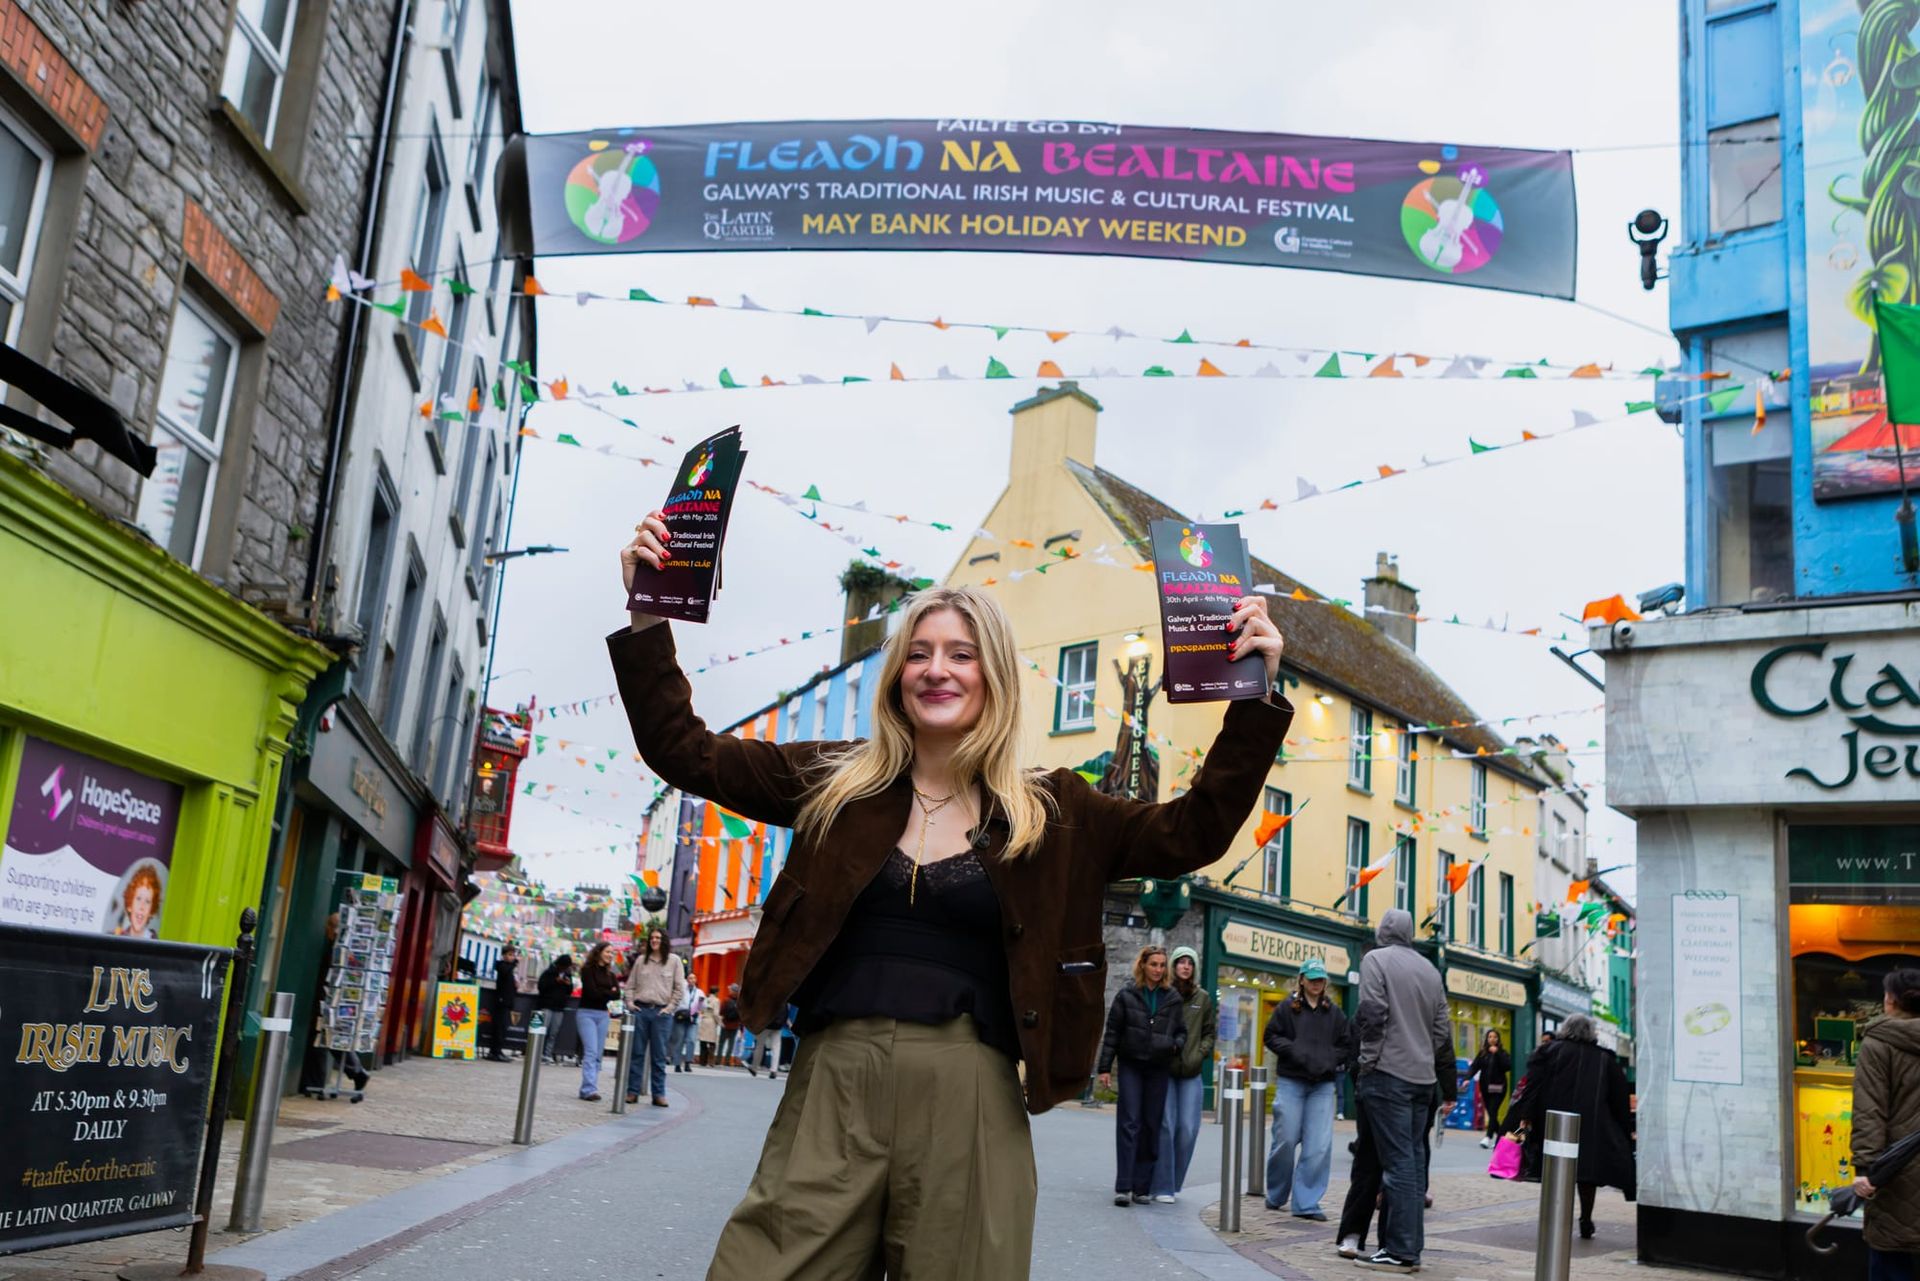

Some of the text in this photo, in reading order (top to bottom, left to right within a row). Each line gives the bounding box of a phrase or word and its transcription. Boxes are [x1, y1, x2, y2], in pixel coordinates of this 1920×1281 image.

[1027, 120, 1070, 135] GO
[703, 134, 1356, 193] FLEADH NA BEALTAINE
[703, 182, 1355, 222] GALWAY'S TRADITIONAL IRISH MUSIC & CULTURAL FESTIVAL
[721, 208, 773, 224] LATIN
[703, 220, 776, 240] QUARTER
[802, 213, 1247, 247] MAY BANK HOLIDAY WEEKEND
[704, 490, 721, 500] NA
[692, 514, 704, 522] May
[670, 541, 692, 549] Cultural
[693, 541, 715, 549] Festival
[672, 531, 702, 539] Traditional
[1219, 574, 1240, 584] NA
[1182, 595, 1198, 604] April
[1167, 615, 1197, 624] Galway's
[1190, 624, 1196, 632] &
[1197, 623, 1225, 631] Cultural
[1750, 642, 1920, 717] Cla
[81, 775, 161, 825] HopeSpace
[7, 867, 96, 899] Supporting children
[2, 895, 95, 924] who are grieving the
[1250, 931, 1327, 963] EVERGREEN
[83, 966, 159, 1013] LIVE
[16, 1022, 192, 1074] IRISH MUSIC
[31, 1088, 167, 1116] AT 5.30pm & 9.30pm
[73, 1119, 128, 1142] DAILY
[22, 1156, 156, 1189] #taaffesforthecraic
[15, 1205, 58, 1227] LATIN
[60, 1197, 125, 1222] QUARTER
[129, 1190, 176, 1211] GALWAY
